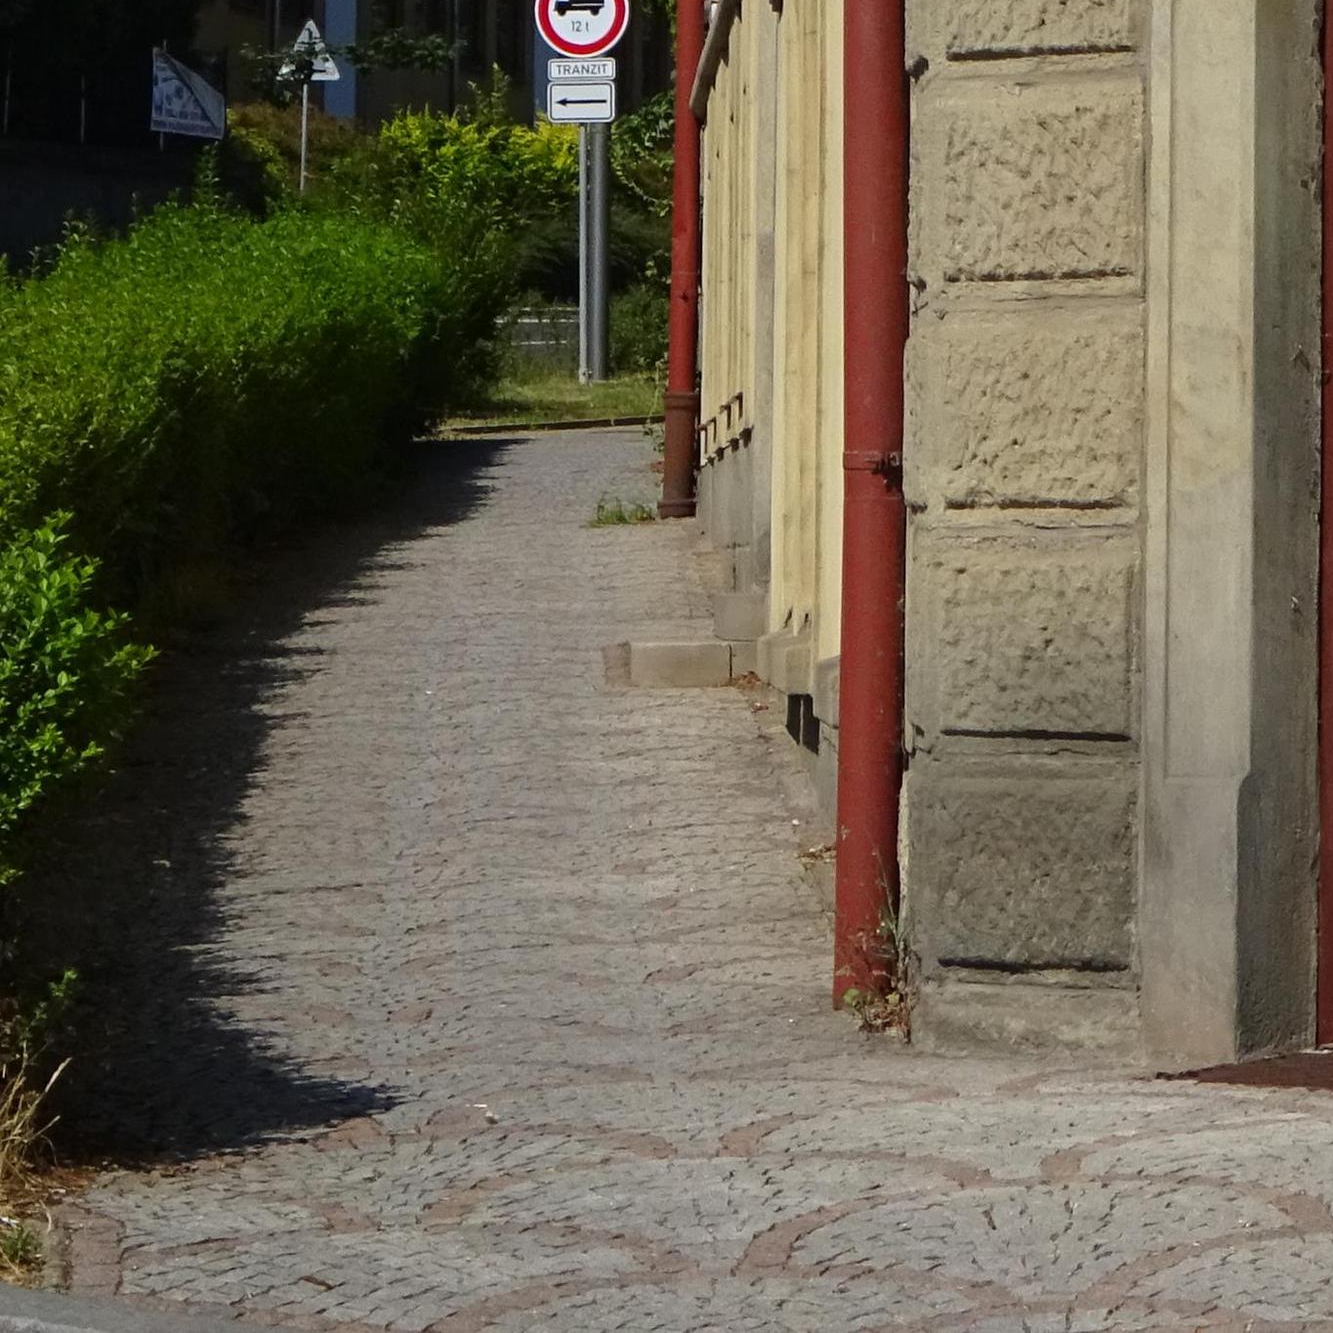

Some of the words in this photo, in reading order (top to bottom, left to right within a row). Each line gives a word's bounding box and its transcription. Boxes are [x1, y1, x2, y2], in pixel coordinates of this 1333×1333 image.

[571, 20, 583, 33] 12
[585, 21, 589, 33] t
[556, 63, 609, 75] TRANZIT
